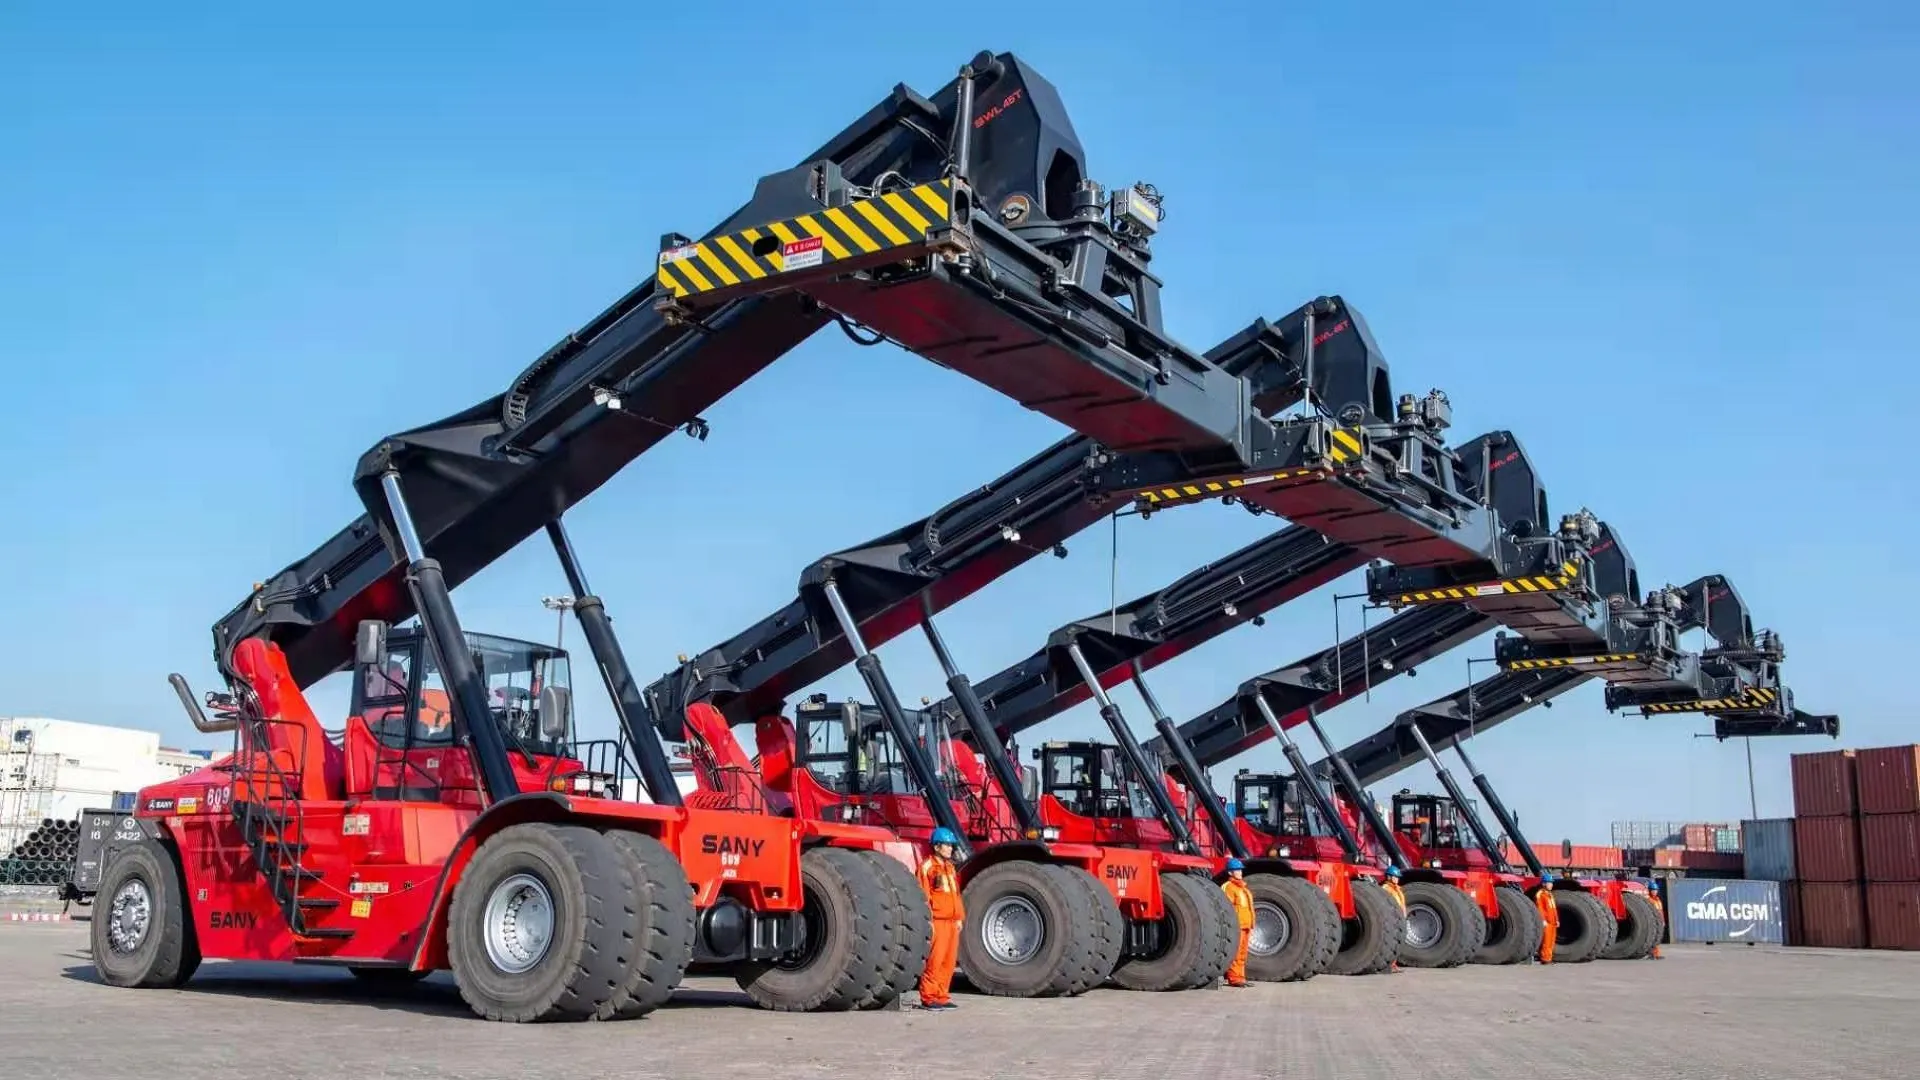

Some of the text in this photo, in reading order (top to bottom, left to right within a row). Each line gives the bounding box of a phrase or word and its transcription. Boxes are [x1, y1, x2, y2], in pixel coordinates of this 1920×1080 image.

[155, 801, 174, 809] SANY
[114, 831, 141, 841] 3422
[702, 834, 765, 857] SANY
[1106, 864, 1138, 880] SANY
[1687, 902, 1768, 920] CMA CGM
[210, 911, 258, 929] SANY
